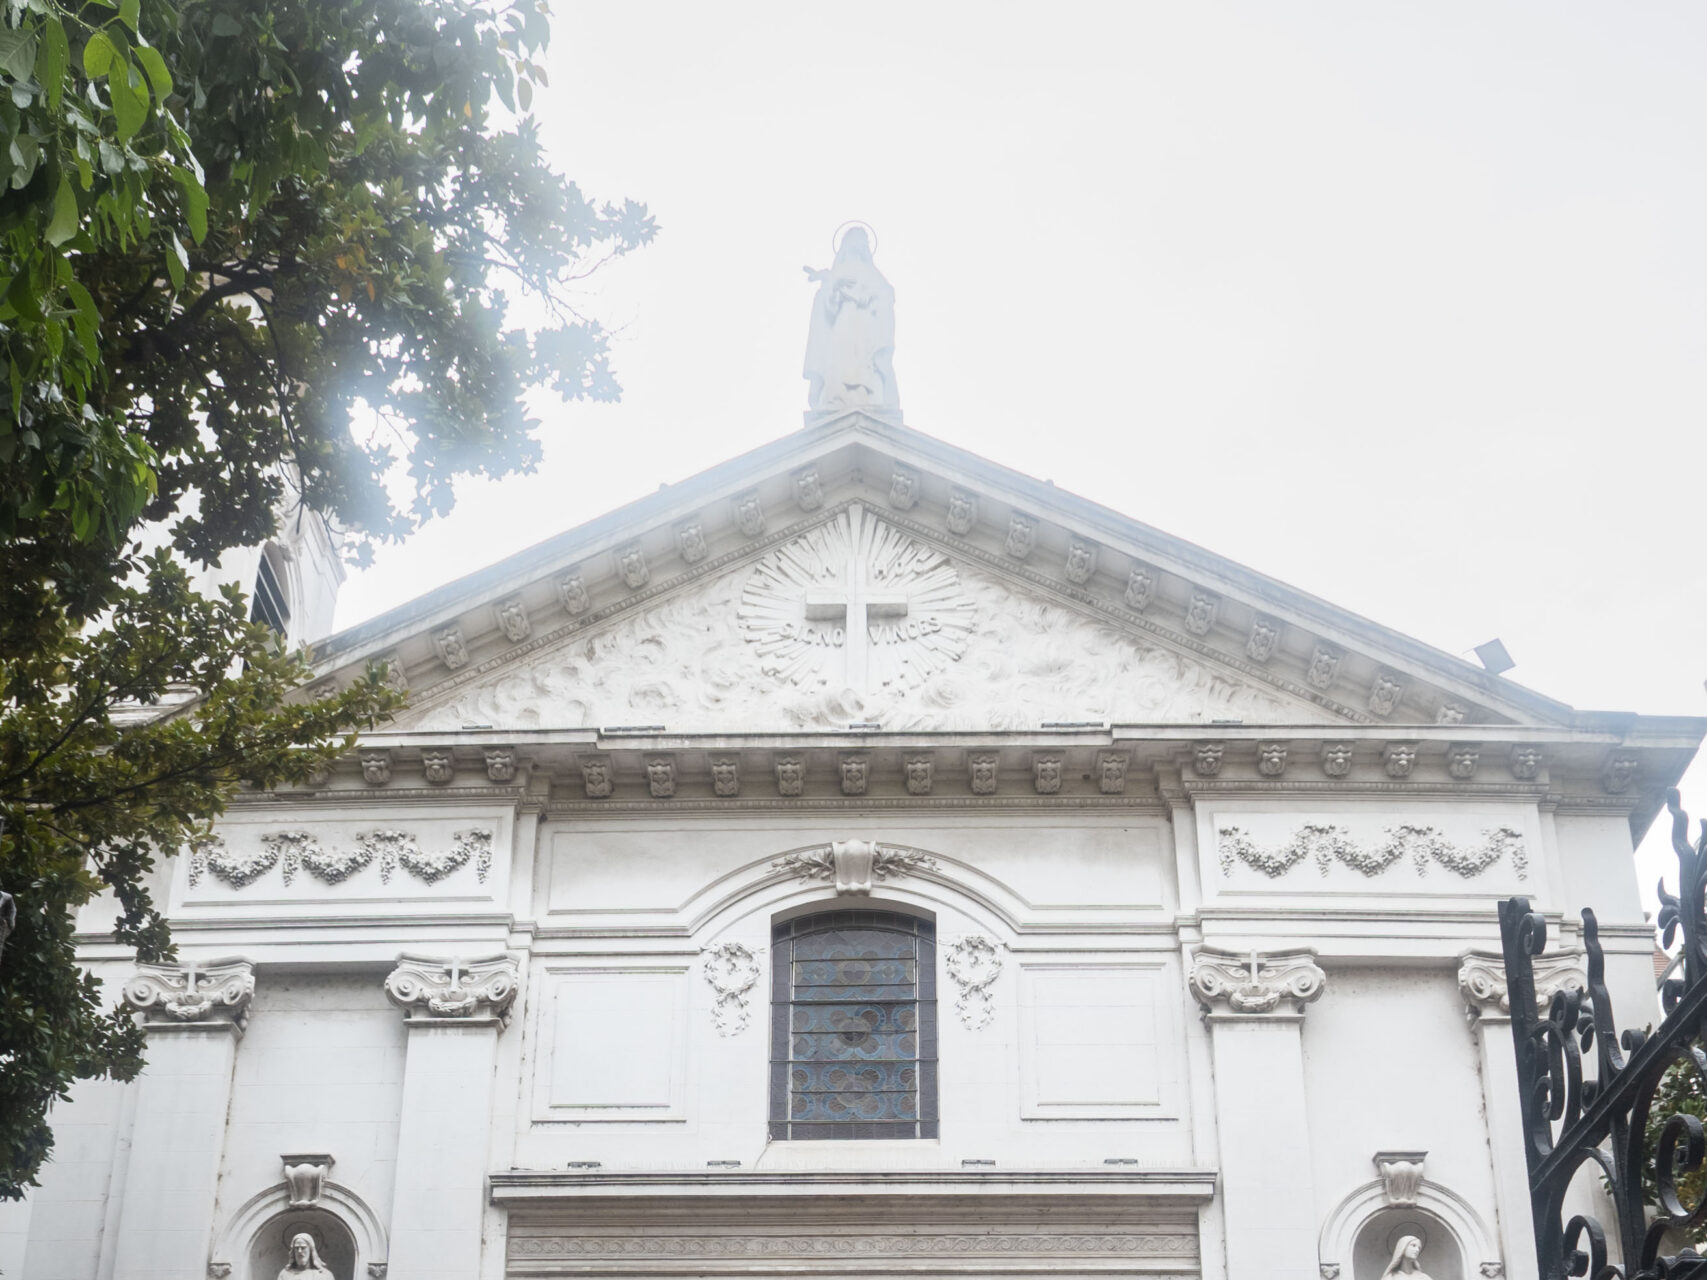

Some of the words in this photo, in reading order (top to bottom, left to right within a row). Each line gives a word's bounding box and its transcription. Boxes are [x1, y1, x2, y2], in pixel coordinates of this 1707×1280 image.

[872, 556, 927, 580] HOC
[779, 623, 845, 648] SIGNO
[867, 617, 943, 647] VINCES
